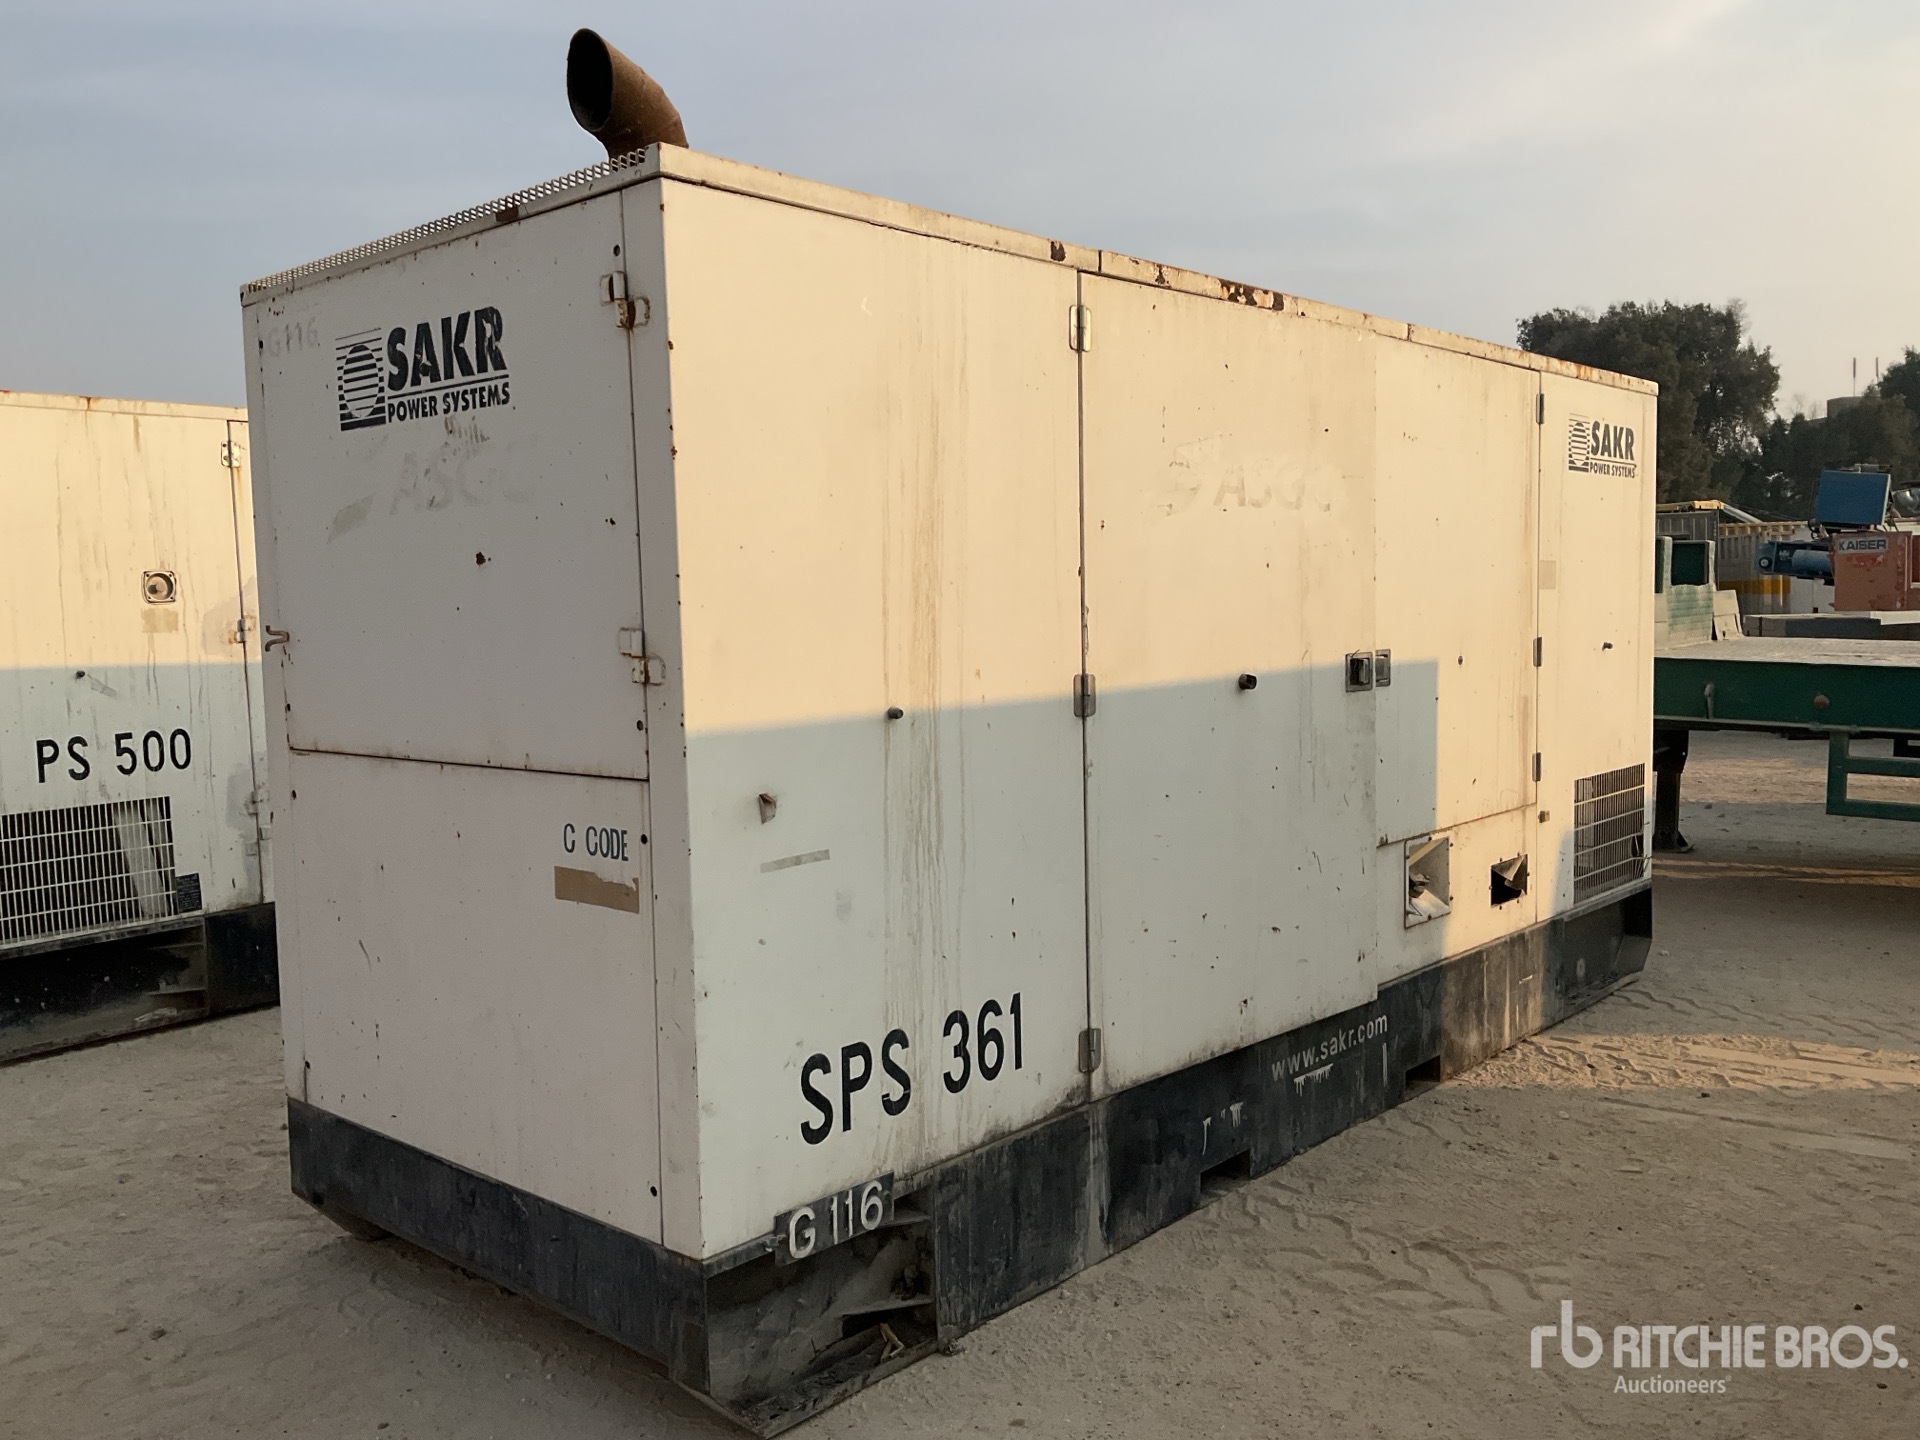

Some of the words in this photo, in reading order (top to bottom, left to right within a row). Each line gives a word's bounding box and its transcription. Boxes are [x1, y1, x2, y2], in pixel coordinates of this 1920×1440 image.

[387, 306, 508, 392] SAKR
[388, 395, 438, 424] POWER
[442, 382, 511, 415] SYSTEMS
[1590, 420, 1635, 461] SAKR
[1589, 462, 1611, 476] POWER
[1611, 464, 1636, 478] SYSTEMS
[1838, 538, 1887, 552] KAISER
[36, 735, 91, 783] PS
[114, 728, 192, 776] 500
[563, 823, 576, 853] C
[585, 826, 629, 861] CODE
[1271, 1013, 1388, 1082] www.sakr.com
[800, 1028, 912, 1146] SPS
[942, 992, 1023, 1094] 361
